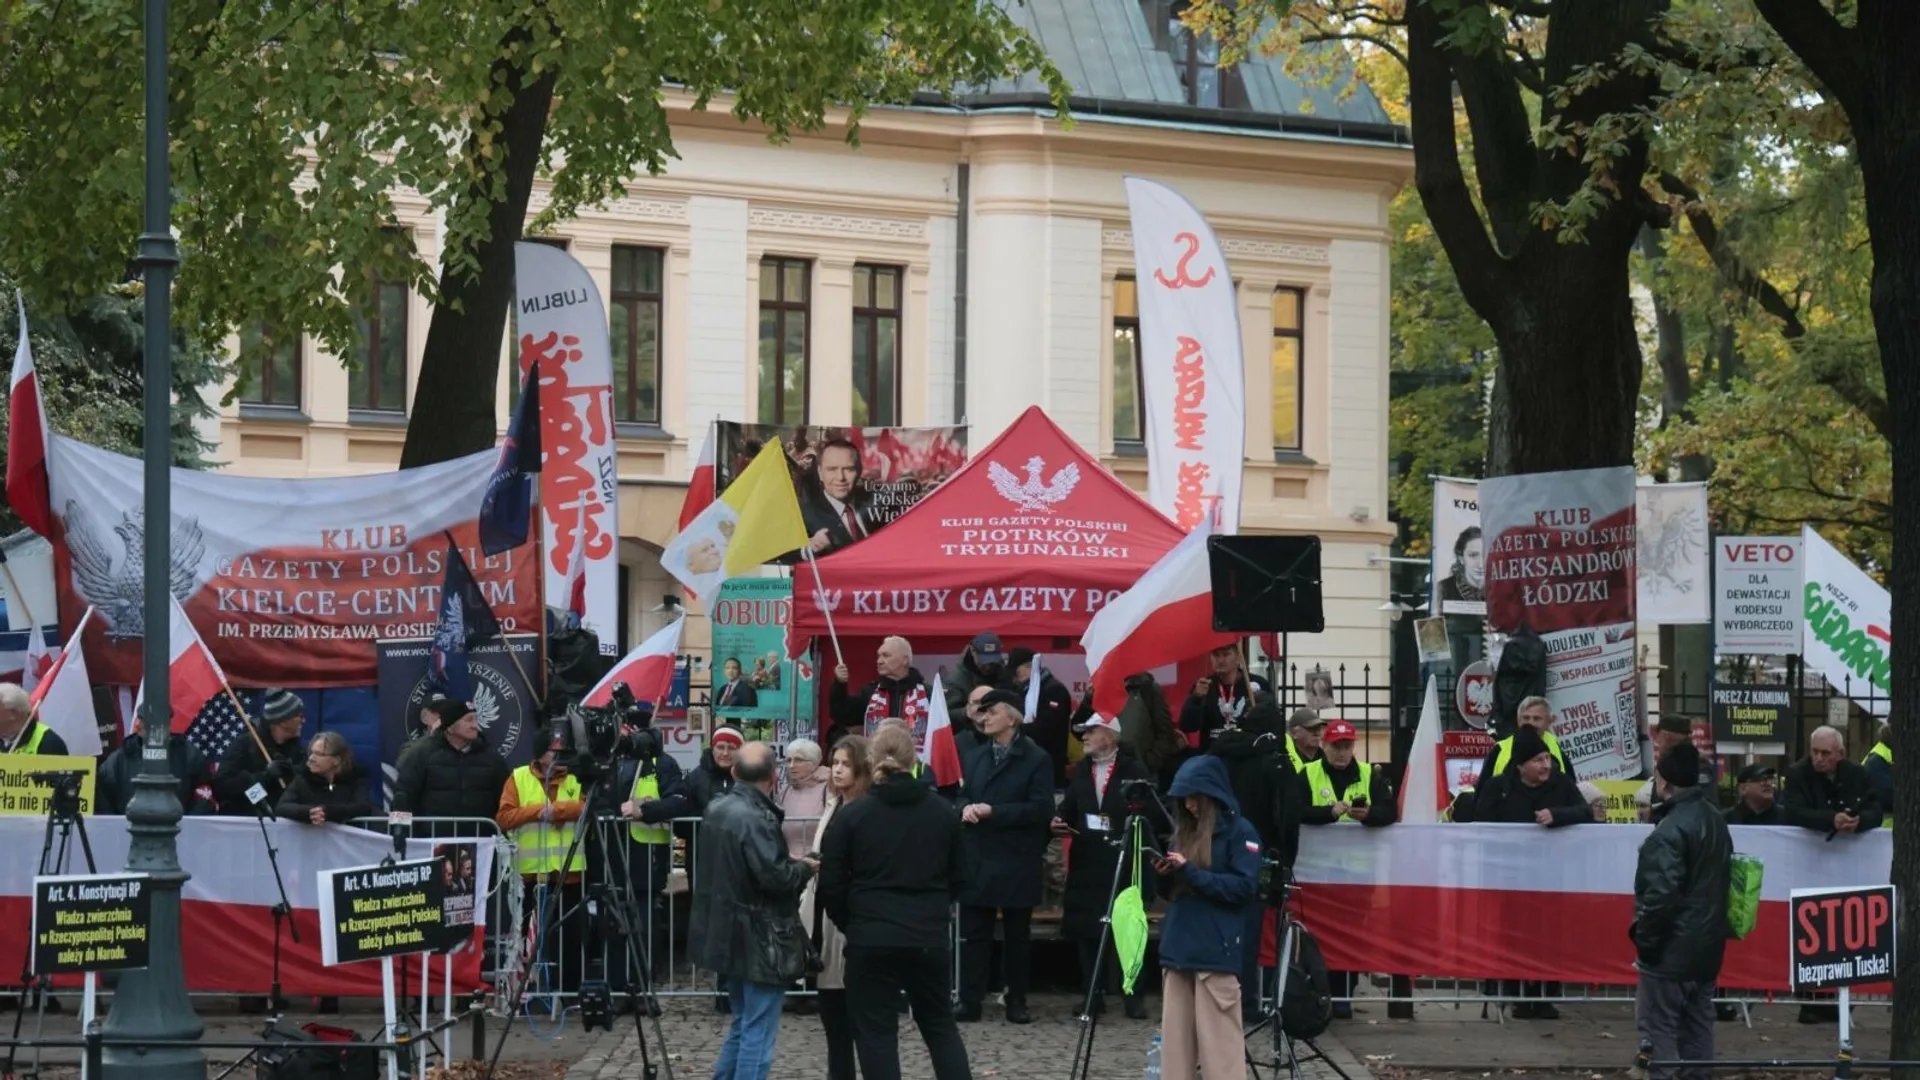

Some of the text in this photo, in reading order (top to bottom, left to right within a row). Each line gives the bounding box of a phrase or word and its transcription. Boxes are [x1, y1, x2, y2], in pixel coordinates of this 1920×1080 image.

[1453, 498, 1480, 513] KTÓ
[941, 516, 1128, 532] KLUB GAZETY POLSKIEJ
[1533, 507, 1592, 528] KLUB
[321, 524, 407, 552] KLUB
[963, 528, 1108, 545] PIOTRKÓW
[941, 544, 1129, 559] TRYBUNALSKI
[1724, 543, 1794, 563] VETO
[215, 547, 513, 580] GAZETY POLSIEJ
[1491, 545, 1636, 581] ALEKSANDRÓW
[1748, 573, 1769, 585] DLA
[215, 578, 516, 616] KIELCE-CENTUM
[853, 588, 951, 615] KLUBY
[960, 587, 1077, 613] GAZETY
[1523, 578, 1609, 607] ŁÓDZKI
[1726, 589, 1791, 600] DEWASTACJI
[1825, 582, 1850, 604] NSZZ
[1734, 604, 1783, 616] KODEKSU
[218, 622, 244, 638] IM.
[249, 622, 380, 640] PRZEMYSŁAWA
[1723, 619, 1794, 631] WYBORCZEGO
[1544, 631, 1596, 655] UDUJEMY
[1714, 689, 1742, 704] PRECZ
[1745, 690, 1751, 705] Z
[1561, 700, 1600, 720] TWOJE
[1732, 705, 1778, 722] Tuskowym
[1552, 711, 1612, 738] WSPARCIE
[1573, 724, 1617, 747] OGROMNE
[1444, 745, 1489, 755] KONSTYT
[0, 768, 29, 788] Ruda
[20, 791, 38, 811] nie
[344, 865, 432, 892] Art. 4. Konstytucji RP
[48, 881, 141, 903] Art. 4. Konstytucji RP
[353, 891, 426, 913] Władza zwierzchnia
[56, 907, 132, 925] Władza zwierzchnia
[348, 911, 411, 933] Rzeczypospolitej
[412, 906, 442, 923] Polskiej
[1797, 894, 1888, 956] STOP
[115, 924, 146, 942] Polskiej
[358, 928, 425, 950] należy do Narodu.
[57, 948, 84, 966] należy
[85, 946, 95, 962] do
[1798, 952, 1890, 986] bezprawiu Tuska!
